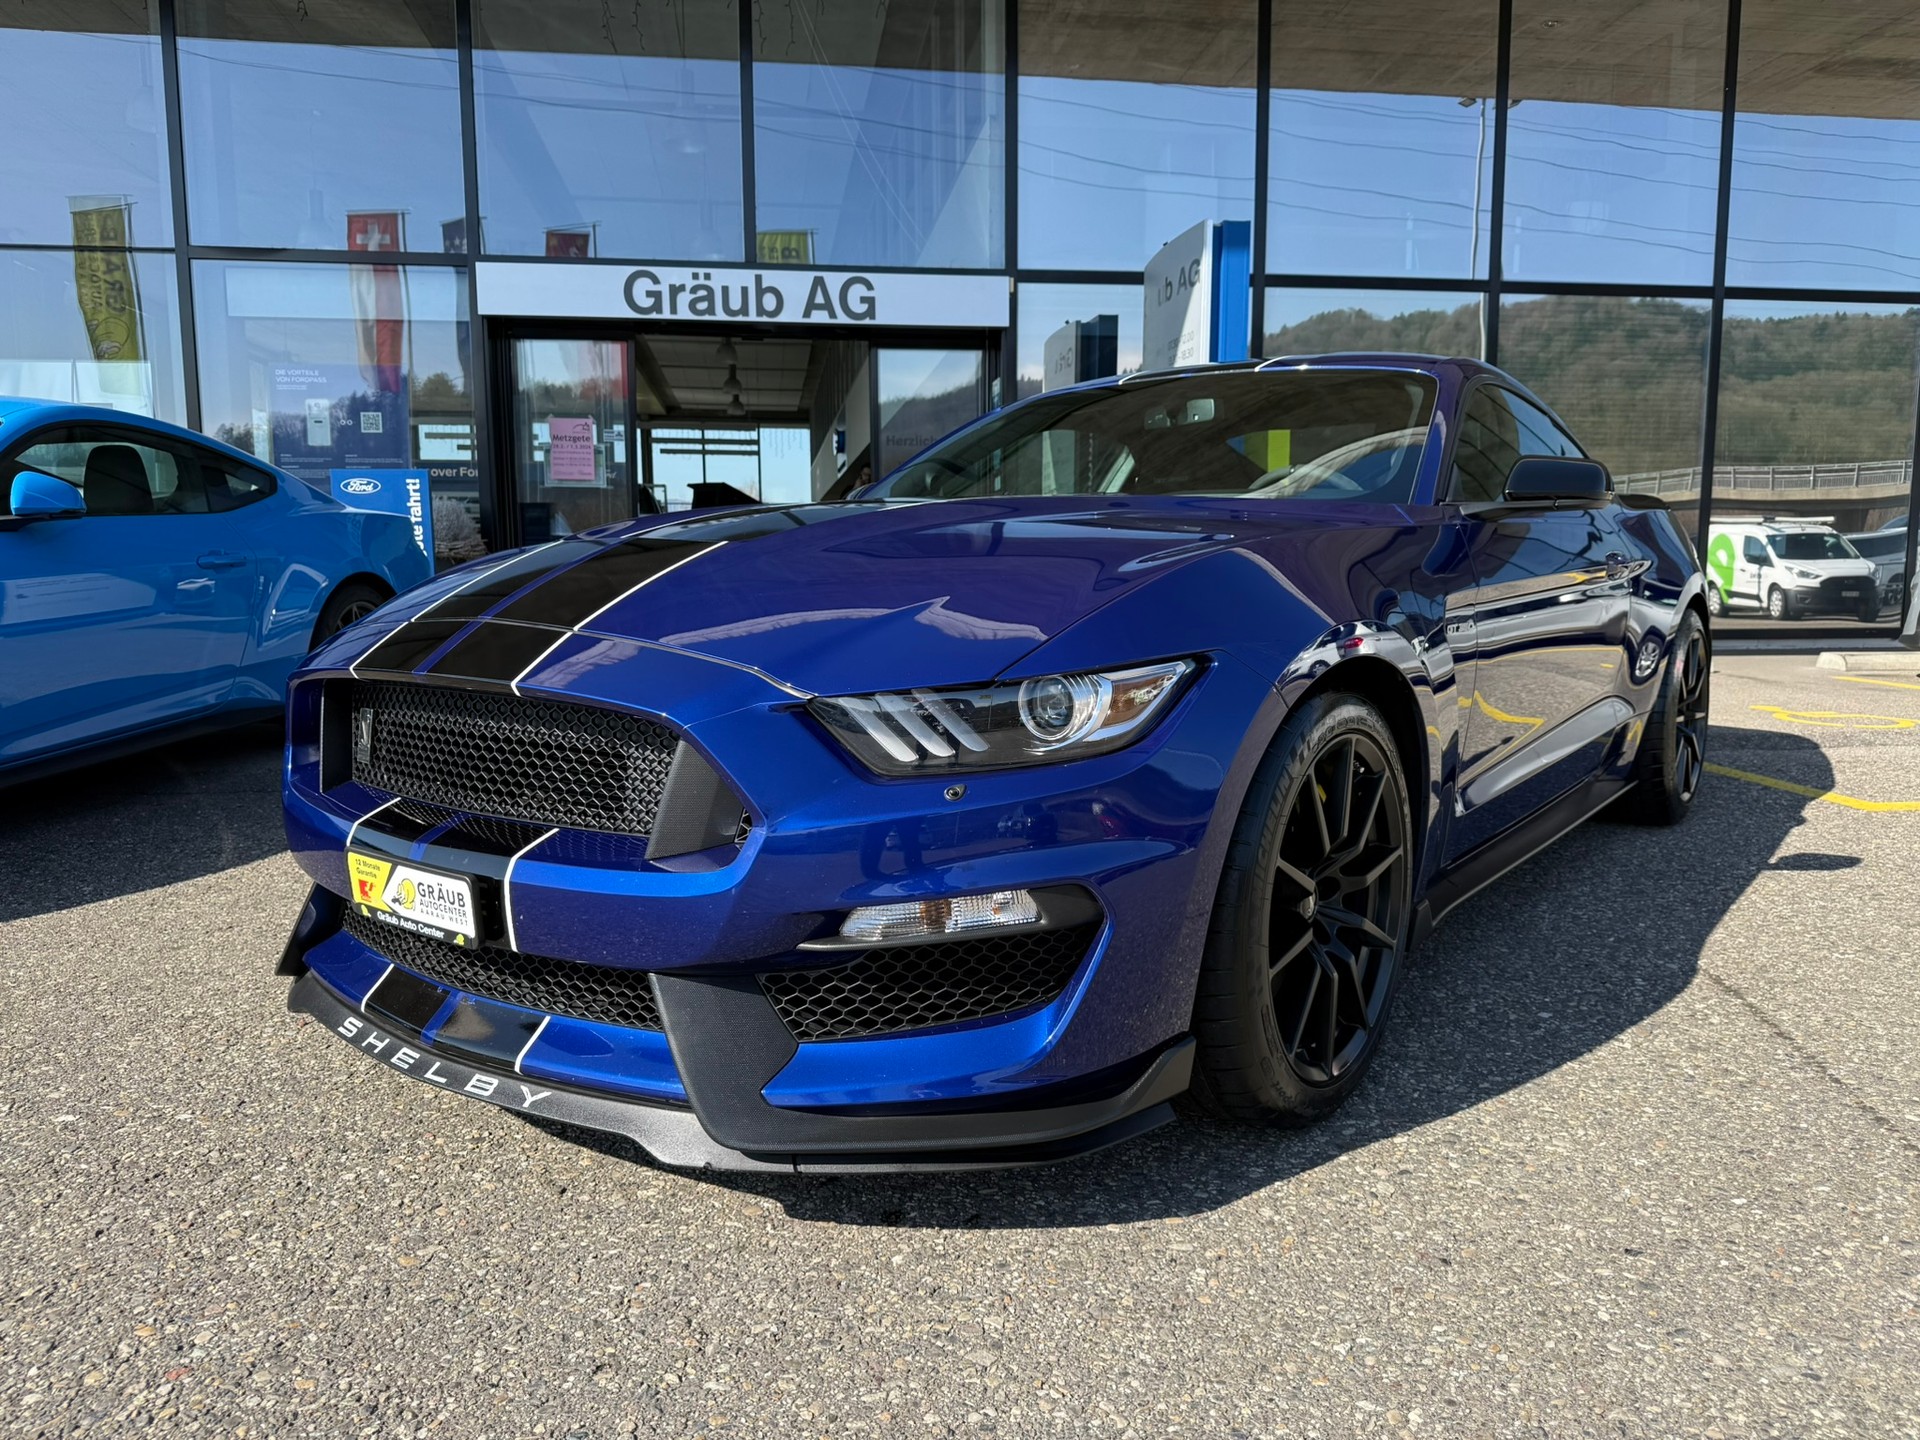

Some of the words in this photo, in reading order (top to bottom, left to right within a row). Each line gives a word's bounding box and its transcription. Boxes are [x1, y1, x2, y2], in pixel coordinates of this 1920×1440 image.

[1176, 258, 1201, 296] AG
[623, 269, 784, 319] Gräub
[802, 275, 876, 321] AG
[553, 434, 591, 443] Metzgete
[430, 467, 456, 477] over
[417, 881, 466, 908] GRÄUB
[420, 899, 467, 919] AUTOCENTER
[420, 909, 445, 920] AARAU
[449, 916, 468, 926] WEST
[377, 911, 399, 925] Gräub
[400, 916, 417, 931] Auto
[418, 923, 445, 939] Center
[337, 1016, 552, 1108] SHELBY
